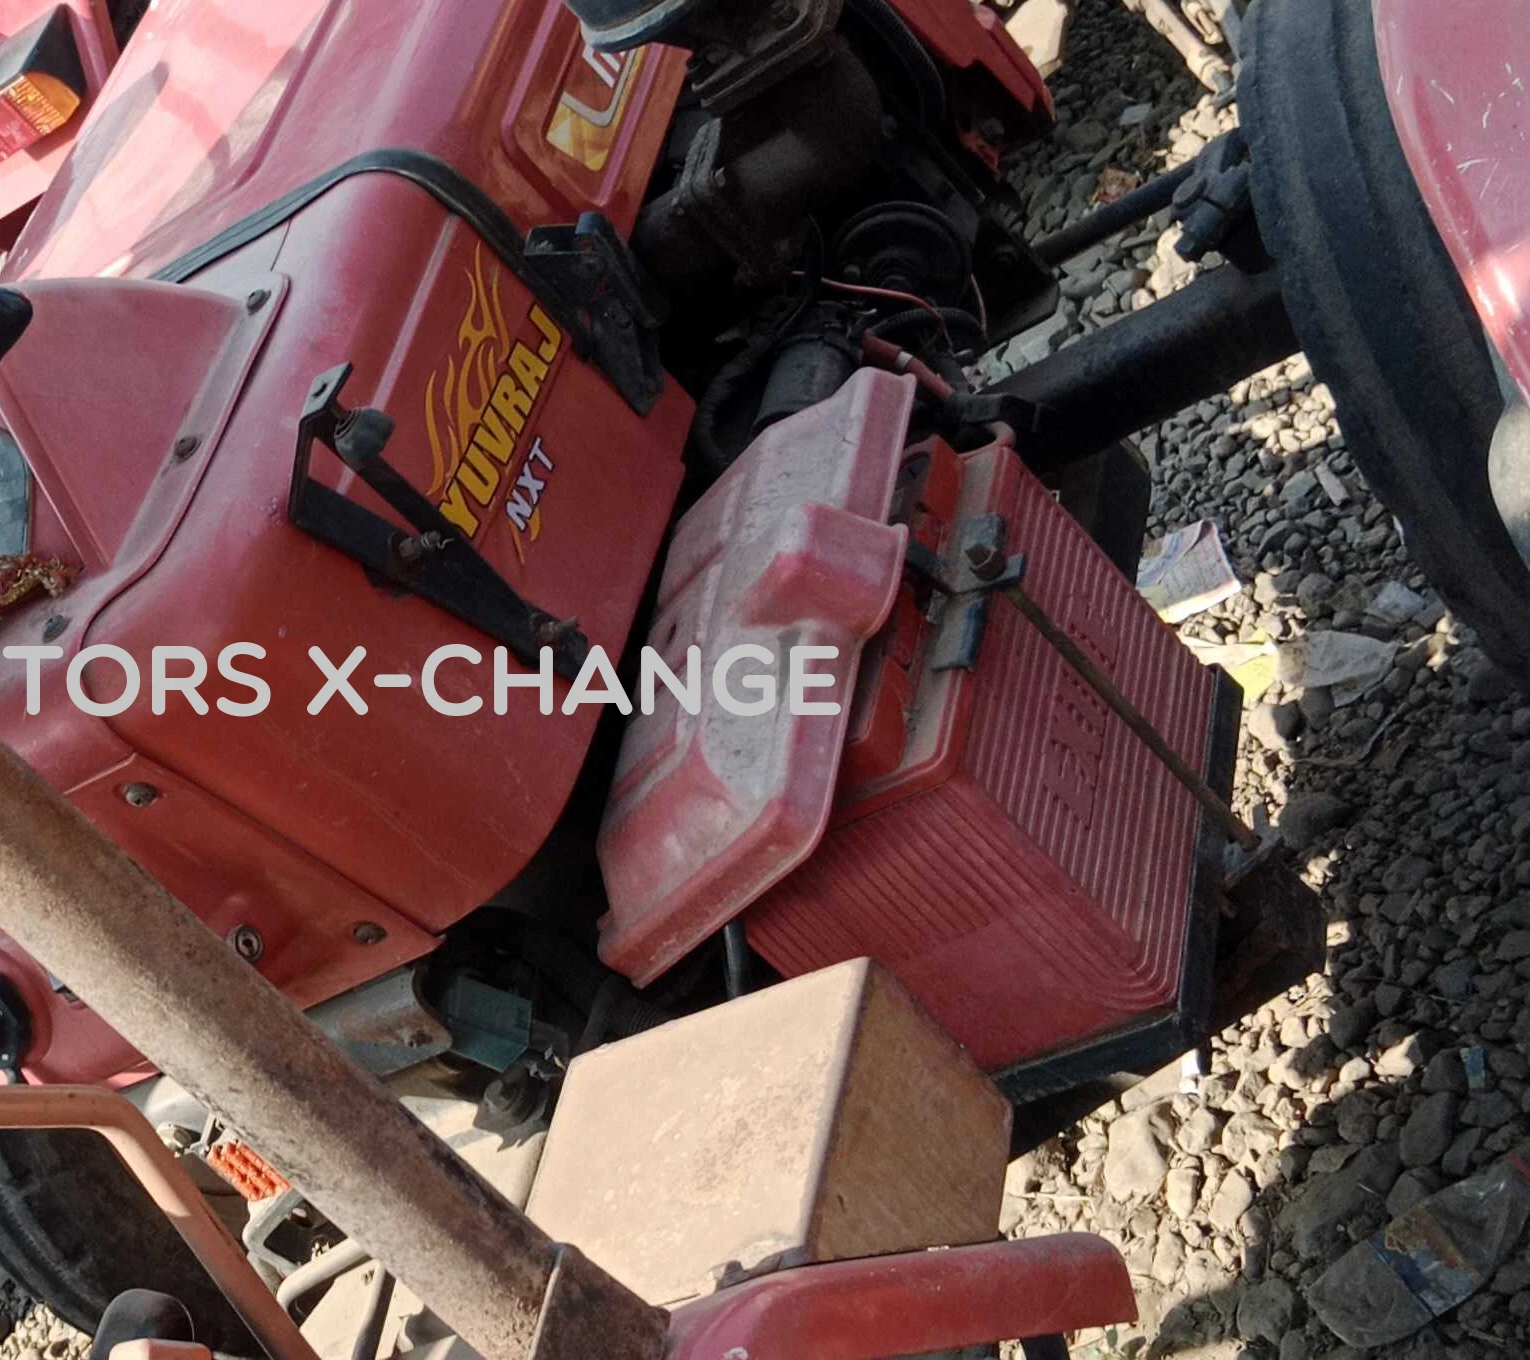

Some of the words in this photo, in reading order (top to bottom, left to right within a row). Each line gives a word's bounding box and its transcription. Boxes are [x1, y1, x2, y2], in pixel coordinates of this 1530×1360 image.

[438, 303, 565, 541] YUVRAJ
[504, 435, 558, 532] NXT
[1043, 601, 1120, 829] EXIE
